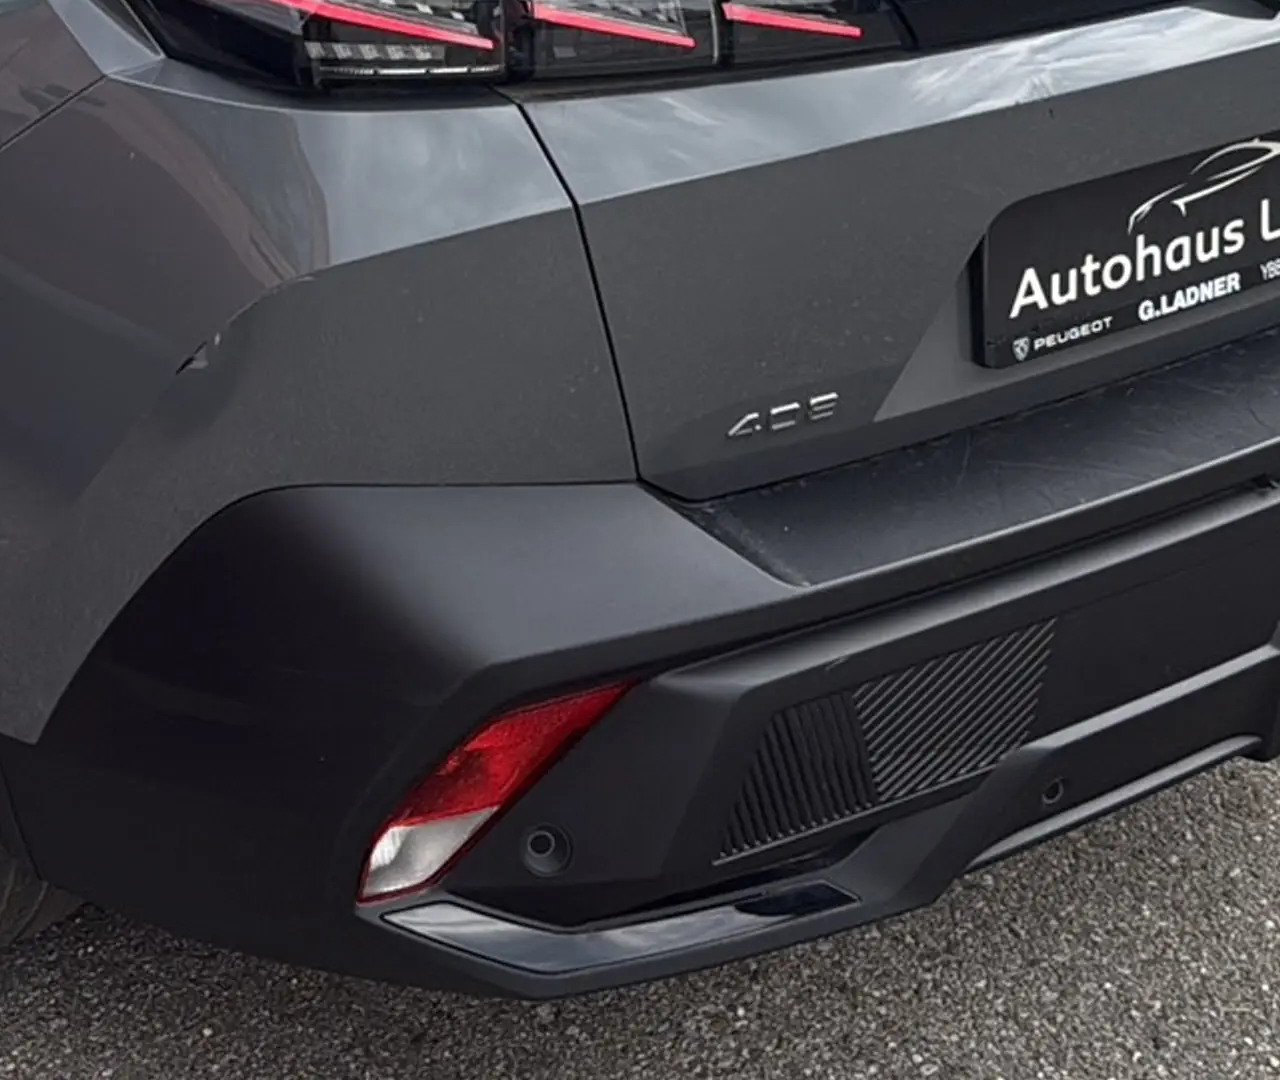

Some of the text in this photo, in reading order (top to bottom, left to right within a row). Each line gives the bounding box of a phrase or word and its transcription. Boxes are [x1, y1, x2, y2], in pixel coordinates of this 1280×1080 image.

[1009, 218, 1245, 320] Autohaus
[1138, 271, 1241, 322] G.LADNER
[1033, 316, 1114, 352] PEUGEOT
[727, 390, 840, 437] 408
